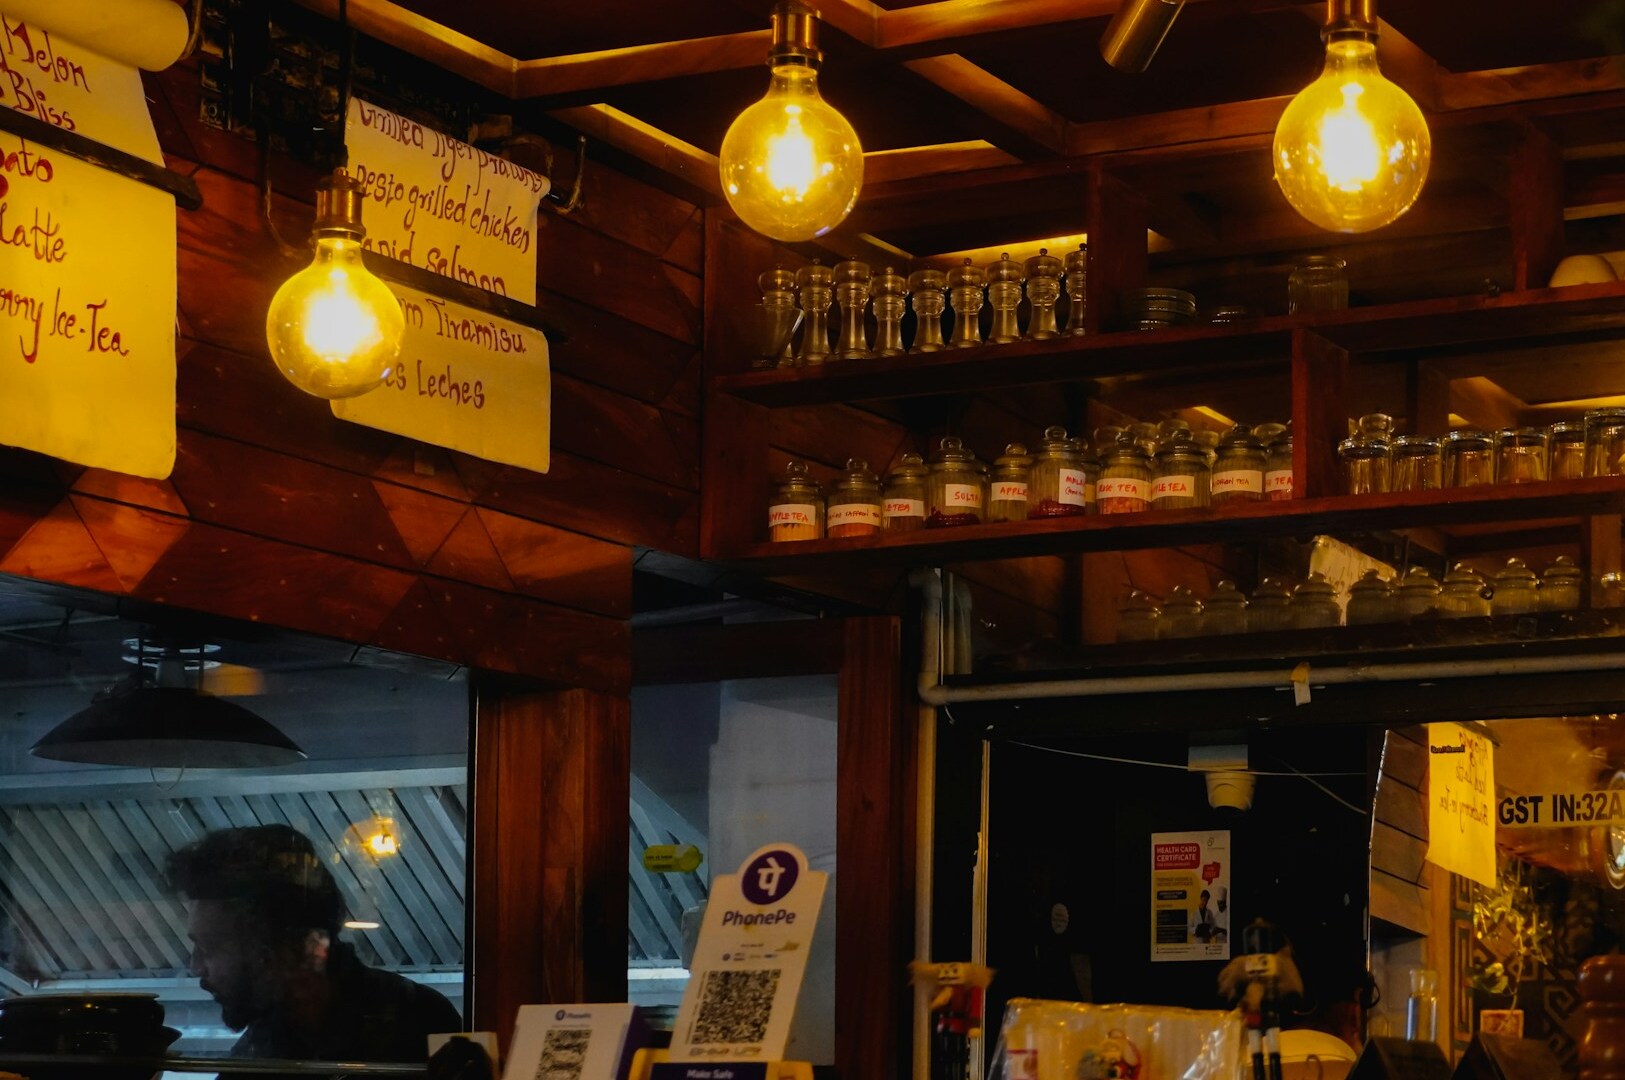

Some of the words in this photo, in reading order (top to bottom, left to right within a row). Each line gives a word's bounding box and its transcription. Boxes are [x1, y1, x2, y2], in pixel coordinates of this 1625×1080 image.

[2, 13, 91, 93] Melon
[7, 69, 76, 131] Bliss
[404, 185, 467, 231] grilled
[470, 189, 530, 254] chicken
[425, 298, 527, 354] Tiramisu
[416, 359, 486, 410] Leches
[1168, 482, 1187, 492] TEA
[1500, 796, 1543, 825] GST
[1157, 846, 1179, 854] HEALTH
[1157, 854, 1197, 862] CERTIFICATE
[722, 909, 796, 927] PhonePe
